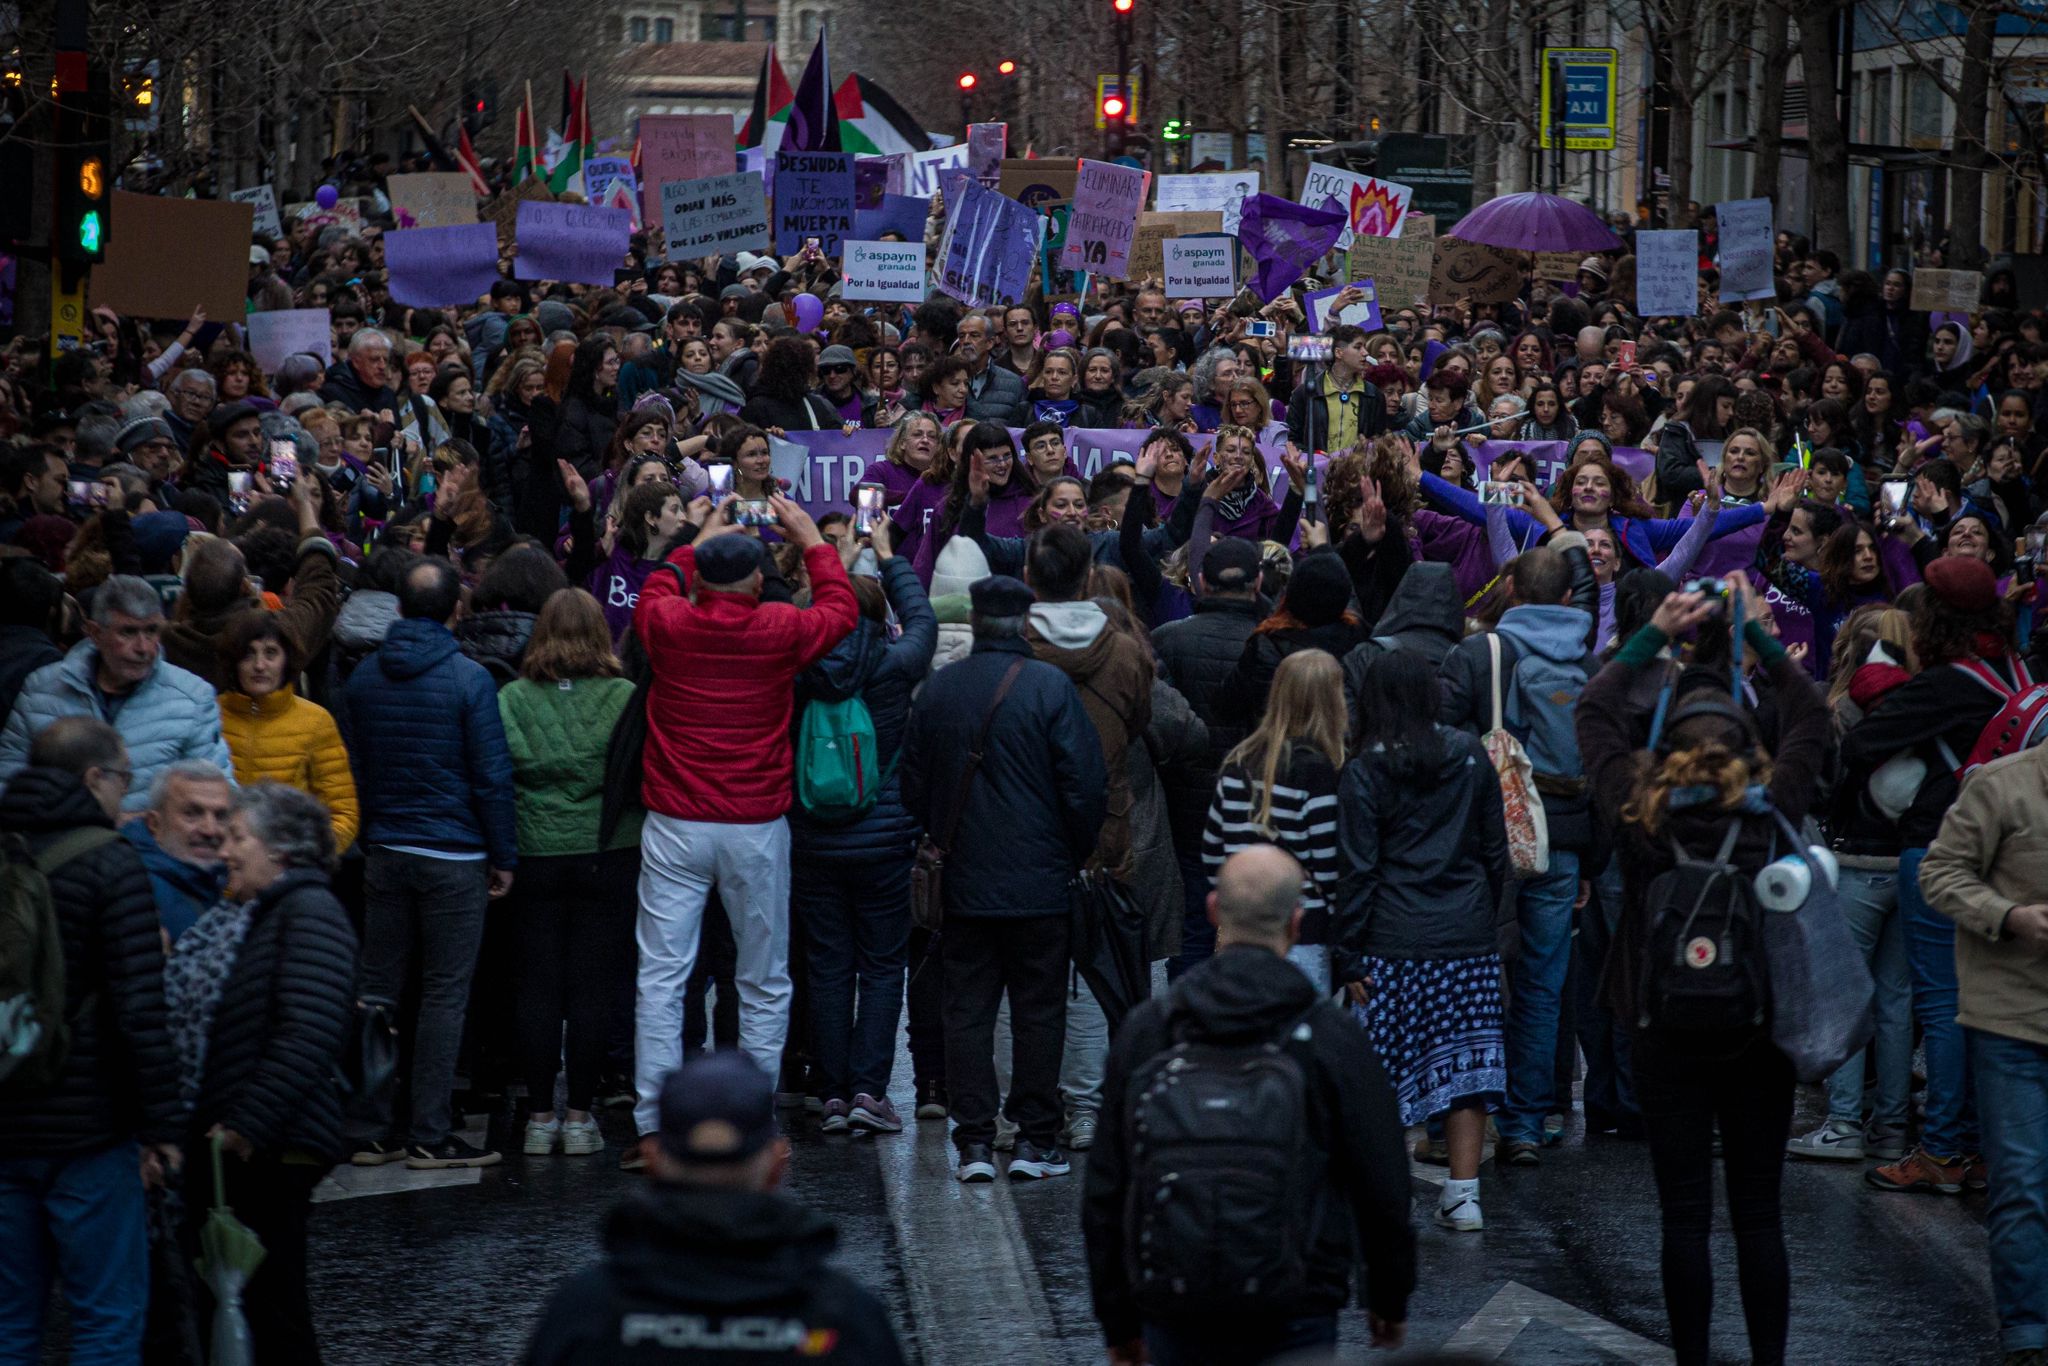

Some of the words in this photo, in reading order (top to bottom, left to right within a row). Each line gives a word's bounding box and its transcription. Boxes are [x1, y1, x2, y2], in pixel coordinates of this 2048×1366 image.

[779, 153, 848, 173] DESNUDA
[797, 178, 821, 195] TE
[674, 199, 705, 214] ODIAN
[711, 191, 737, 208] MÁS
[790, 196, 850, 211] INCOMODA
[783, 215, 850, 233] MUERTA
[869, 252, 917, 263] aspaym
[1084, 240, 1108, 265] YA
[1184, 249, 1225, 259] aspaym
[878, 263, 917, 271] granada
[1192, 259, 1226, 268] granada
[848, 278, 864, 287] Por
[866, 279, 875, 288] la
[877, 280, 920, 290] Igualdad
[1168, 276, 1183, 285] Por
[1184, 275, 1192, 285] la
[1193, 275, 1230, 287] Igualdad
[621, 1313, 807, 1353] POLICIA
